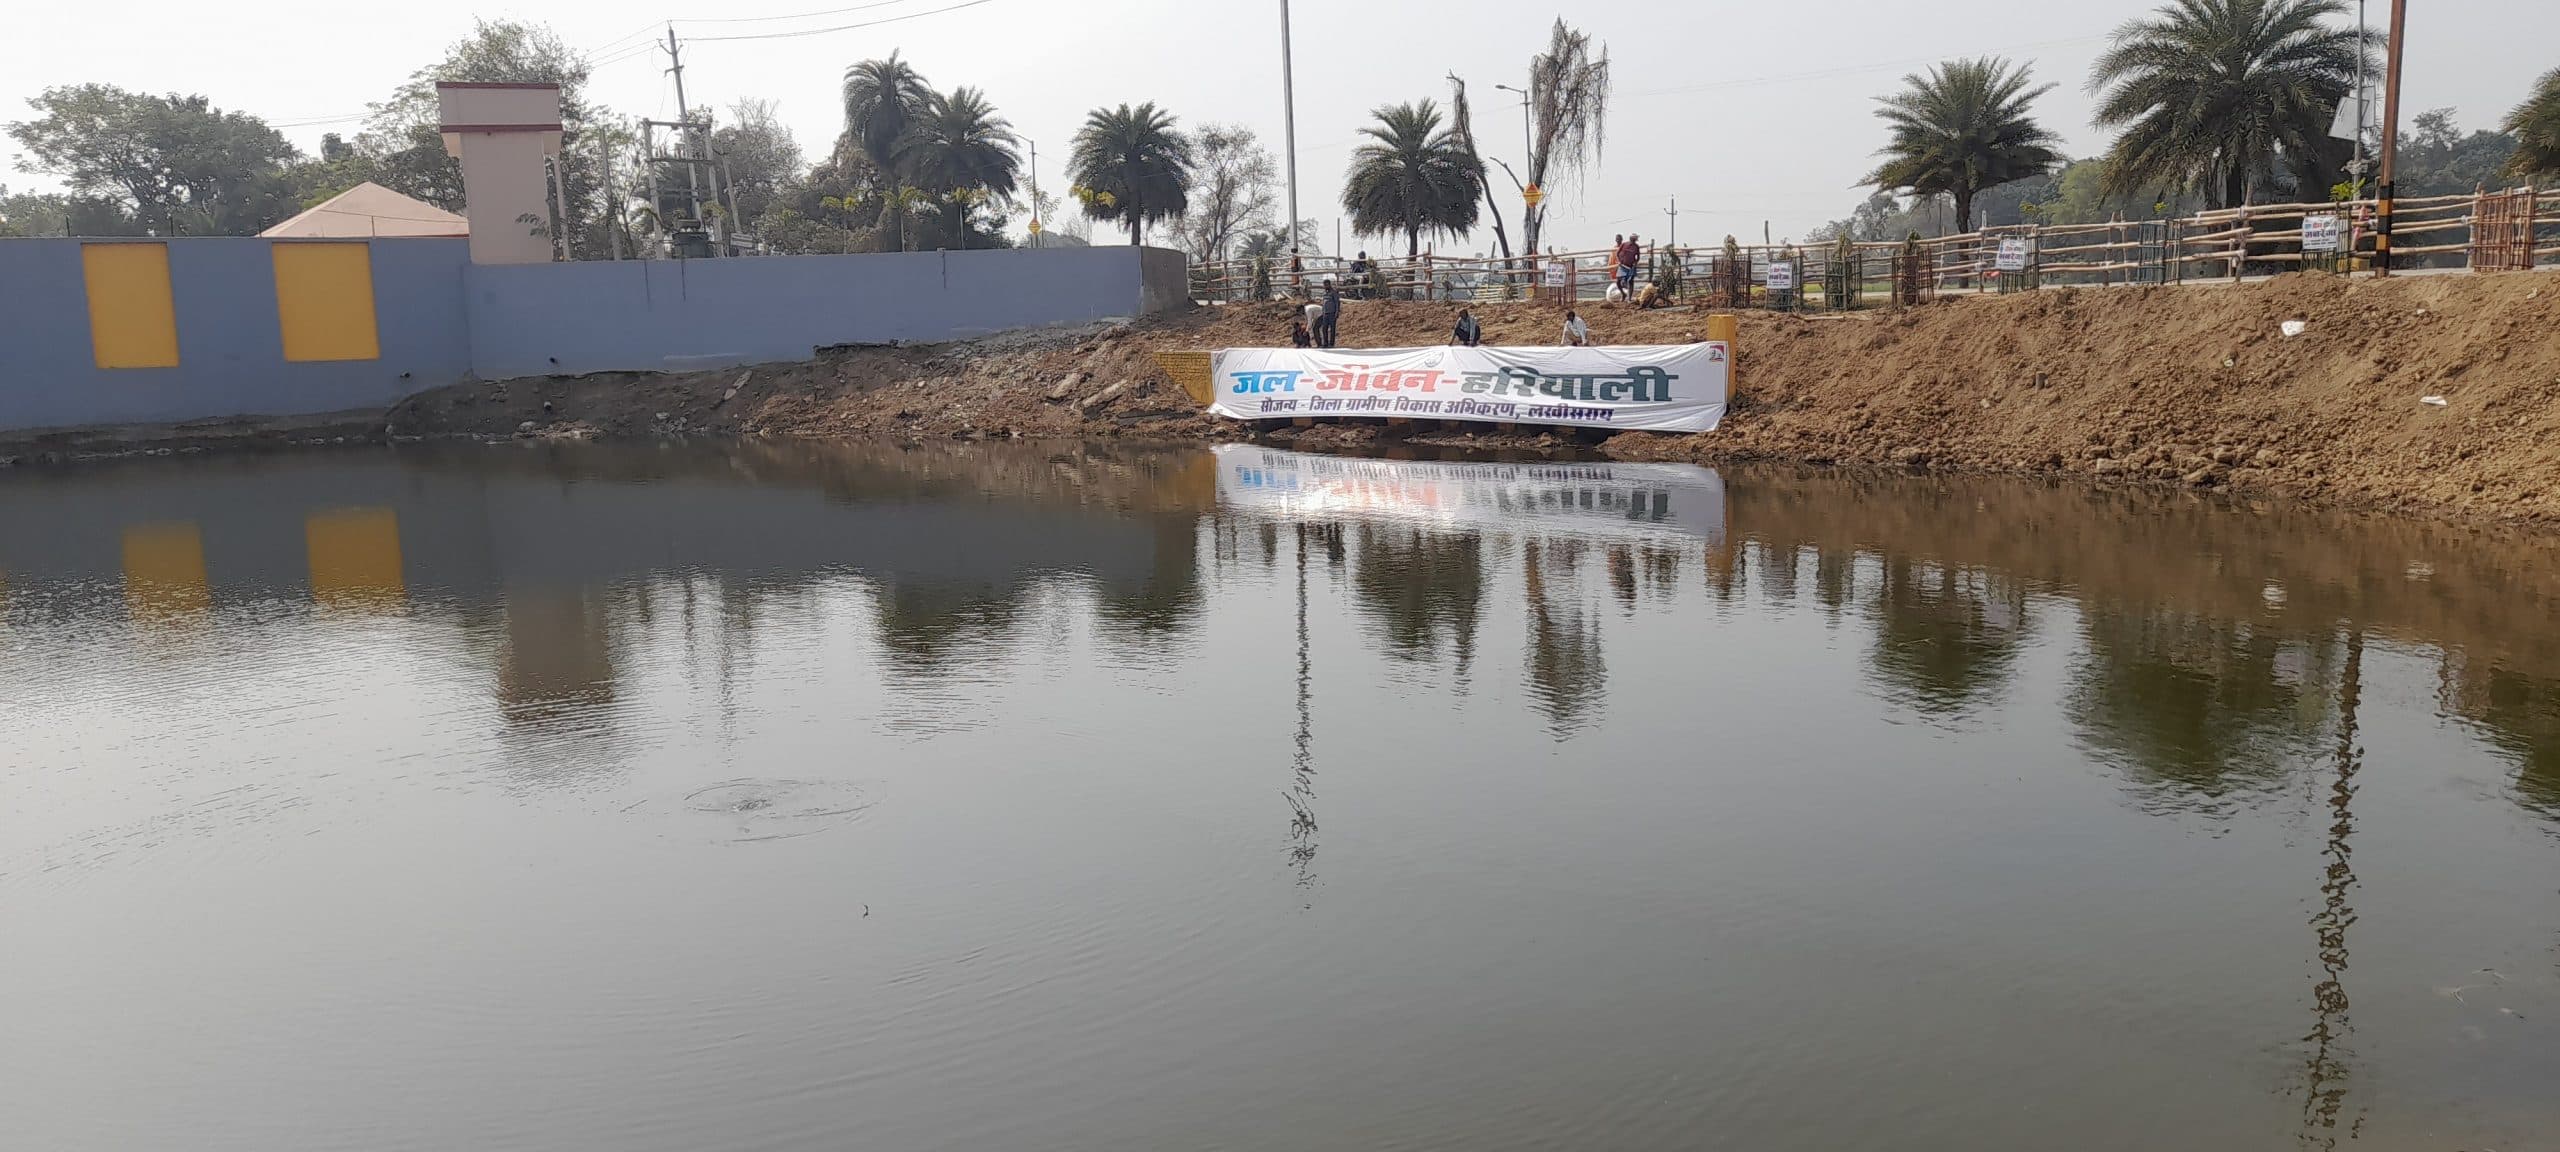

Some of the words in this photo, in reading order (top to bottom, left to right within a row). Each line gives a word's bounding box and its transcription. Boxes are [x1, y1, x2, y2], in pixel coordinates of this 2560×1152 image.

[1309, 396, 1341, 412] जिला
[1346, 396, 1391, 413] ग्रामीण
[1394, 397, 1443, 415] विकास
[1445, 398, 1520, 419] अभिकरण,
